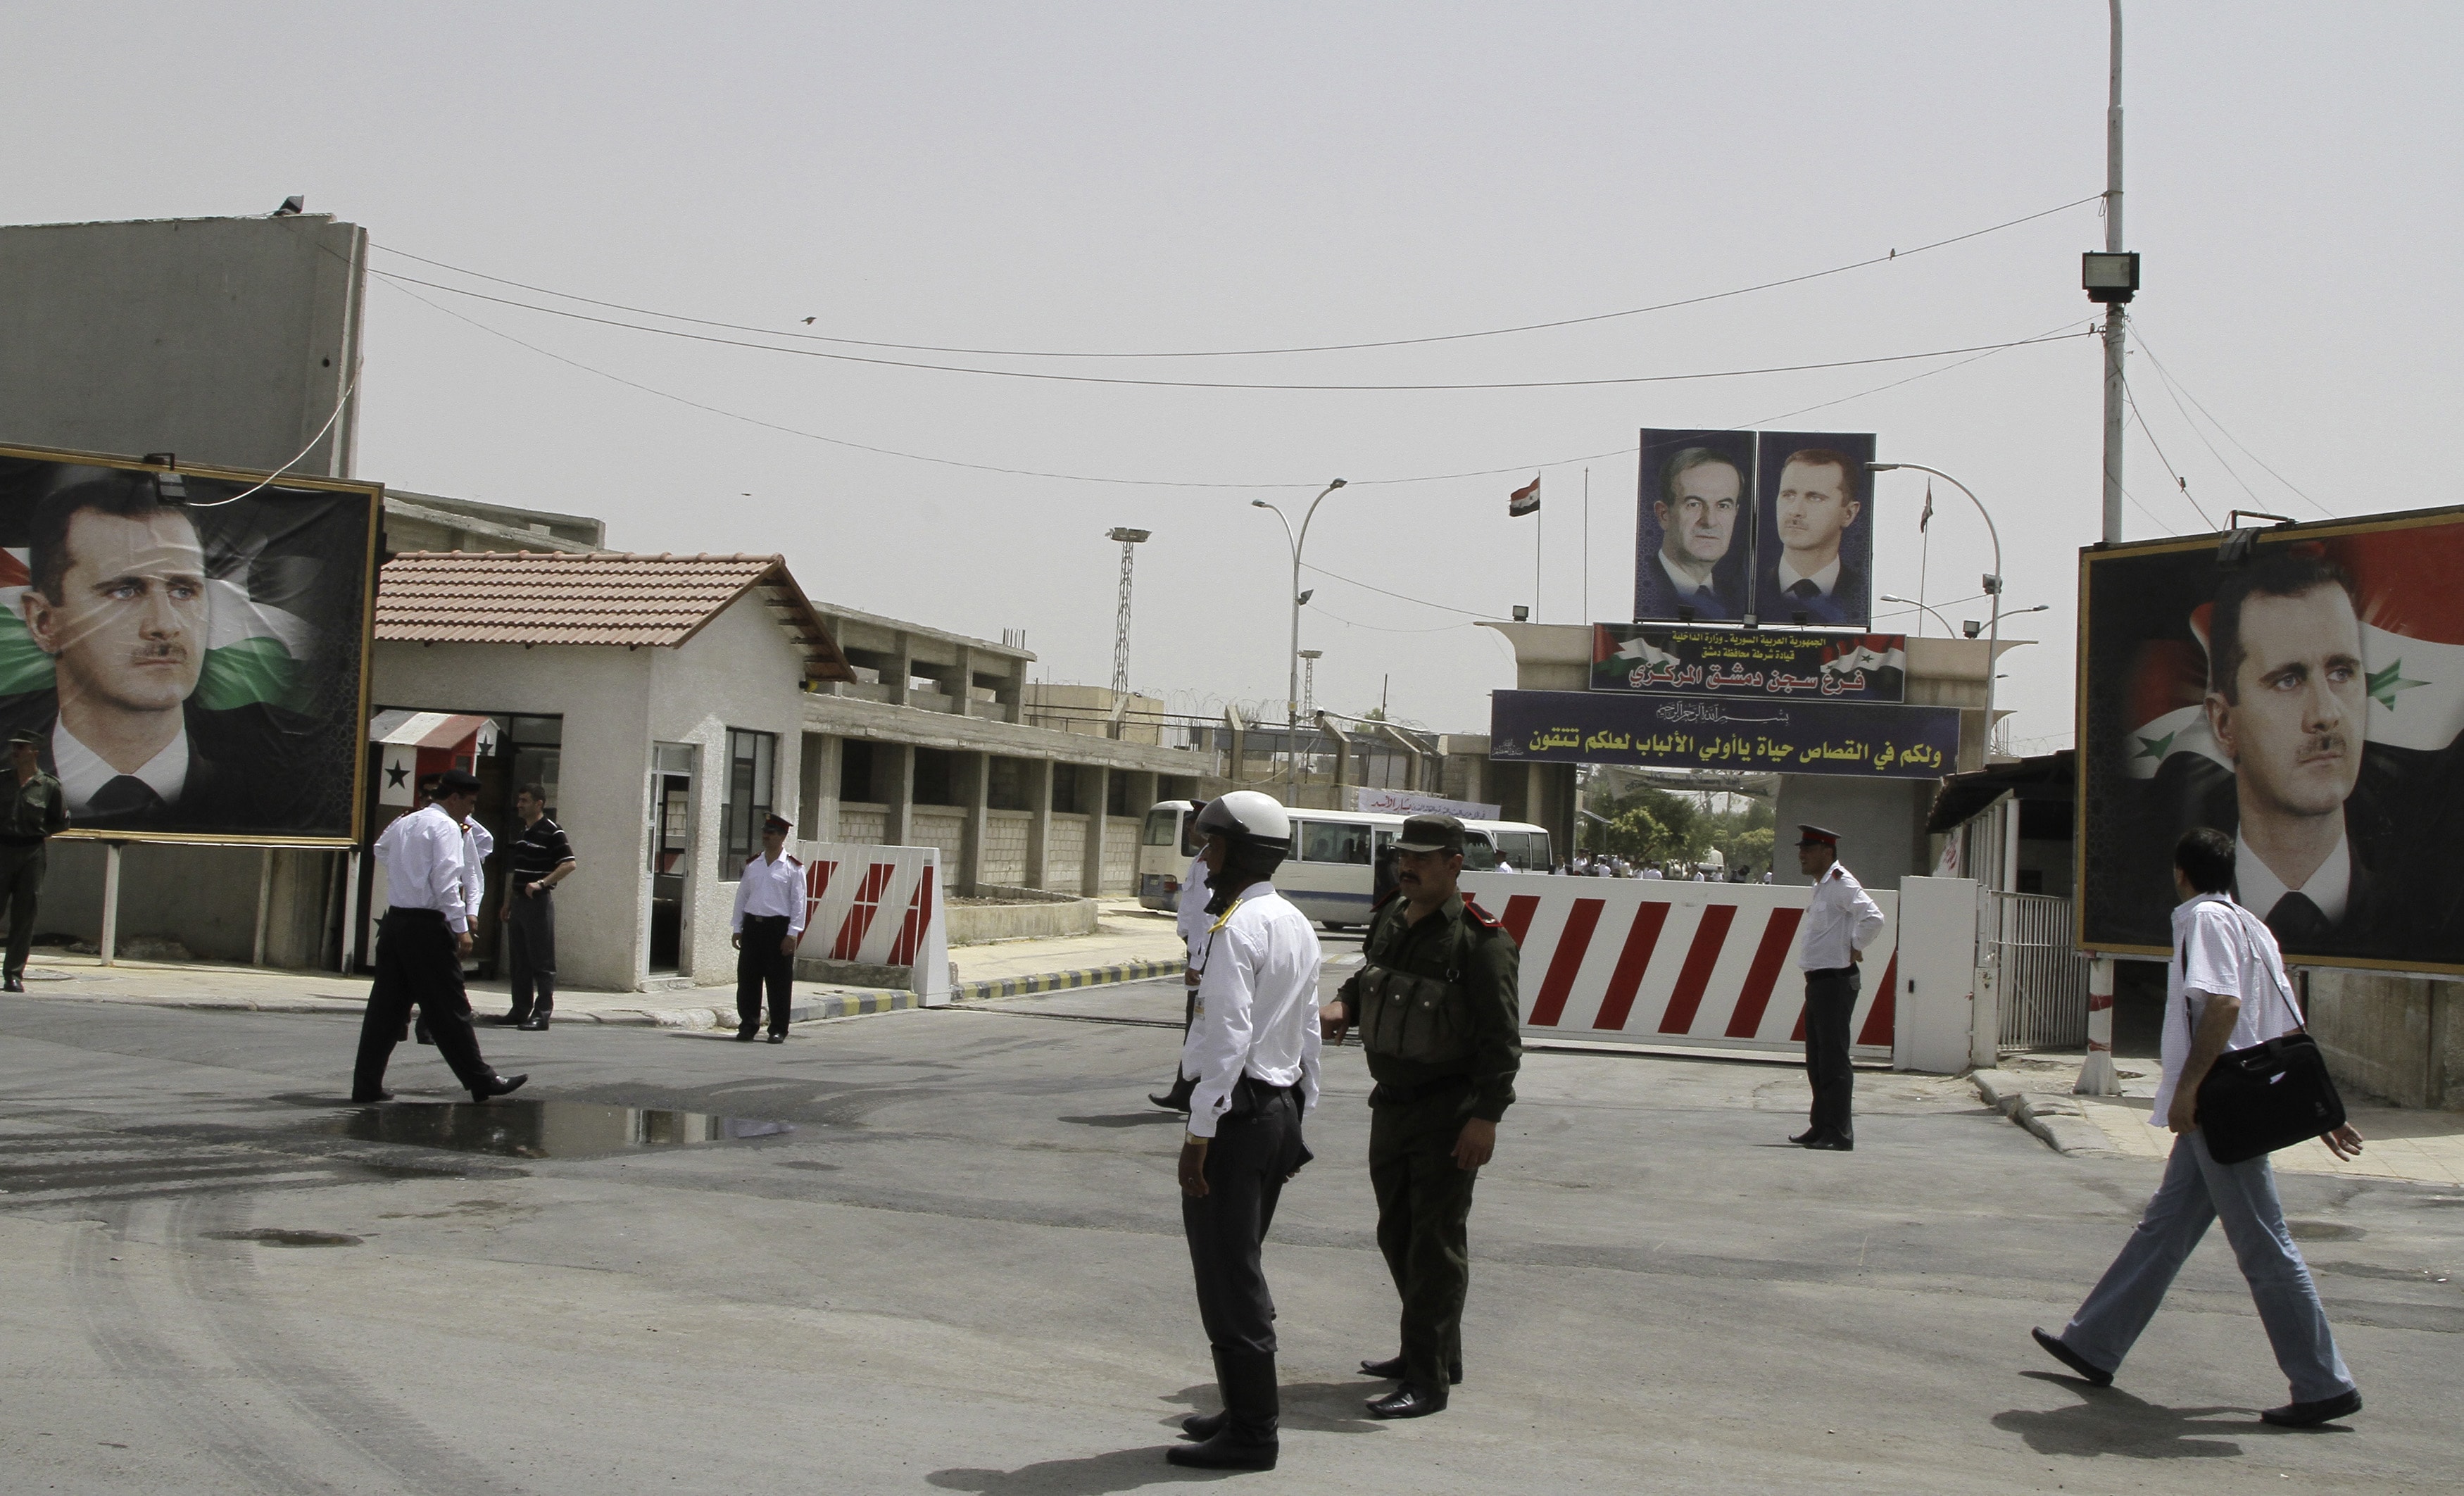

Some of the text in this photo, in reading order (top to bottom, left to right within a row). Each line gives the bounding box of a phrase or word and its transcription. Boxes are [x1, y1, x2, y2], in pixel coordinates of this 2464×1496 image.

[1672, 631, 1702, 642] الداخلية
[1704, 633, 1723, 645] وزارة
[1730, 634, 1758, 646] السورية
[1760, 634, 1787, 646] العربية
[1790, 635, 1826, 648] الجمهورية
[1701, 646, 1794, 662] قيادة شرطة محافظة دمشق
[1628, 662, 1866, 696] فرع سجن دمشق المركزي
[1528, 727, 1580, 751] تتقون
[1585, 729, 1630, 753] لعلكم
[1635, 730, 1694, 758] الألباب
[1756, 736, 1794, 762] حياة
[1799, 739, 1869, 763] القصاص
[1873, 741, 1895, 771] في
[1900, 743, 1942, 768] ولكم
